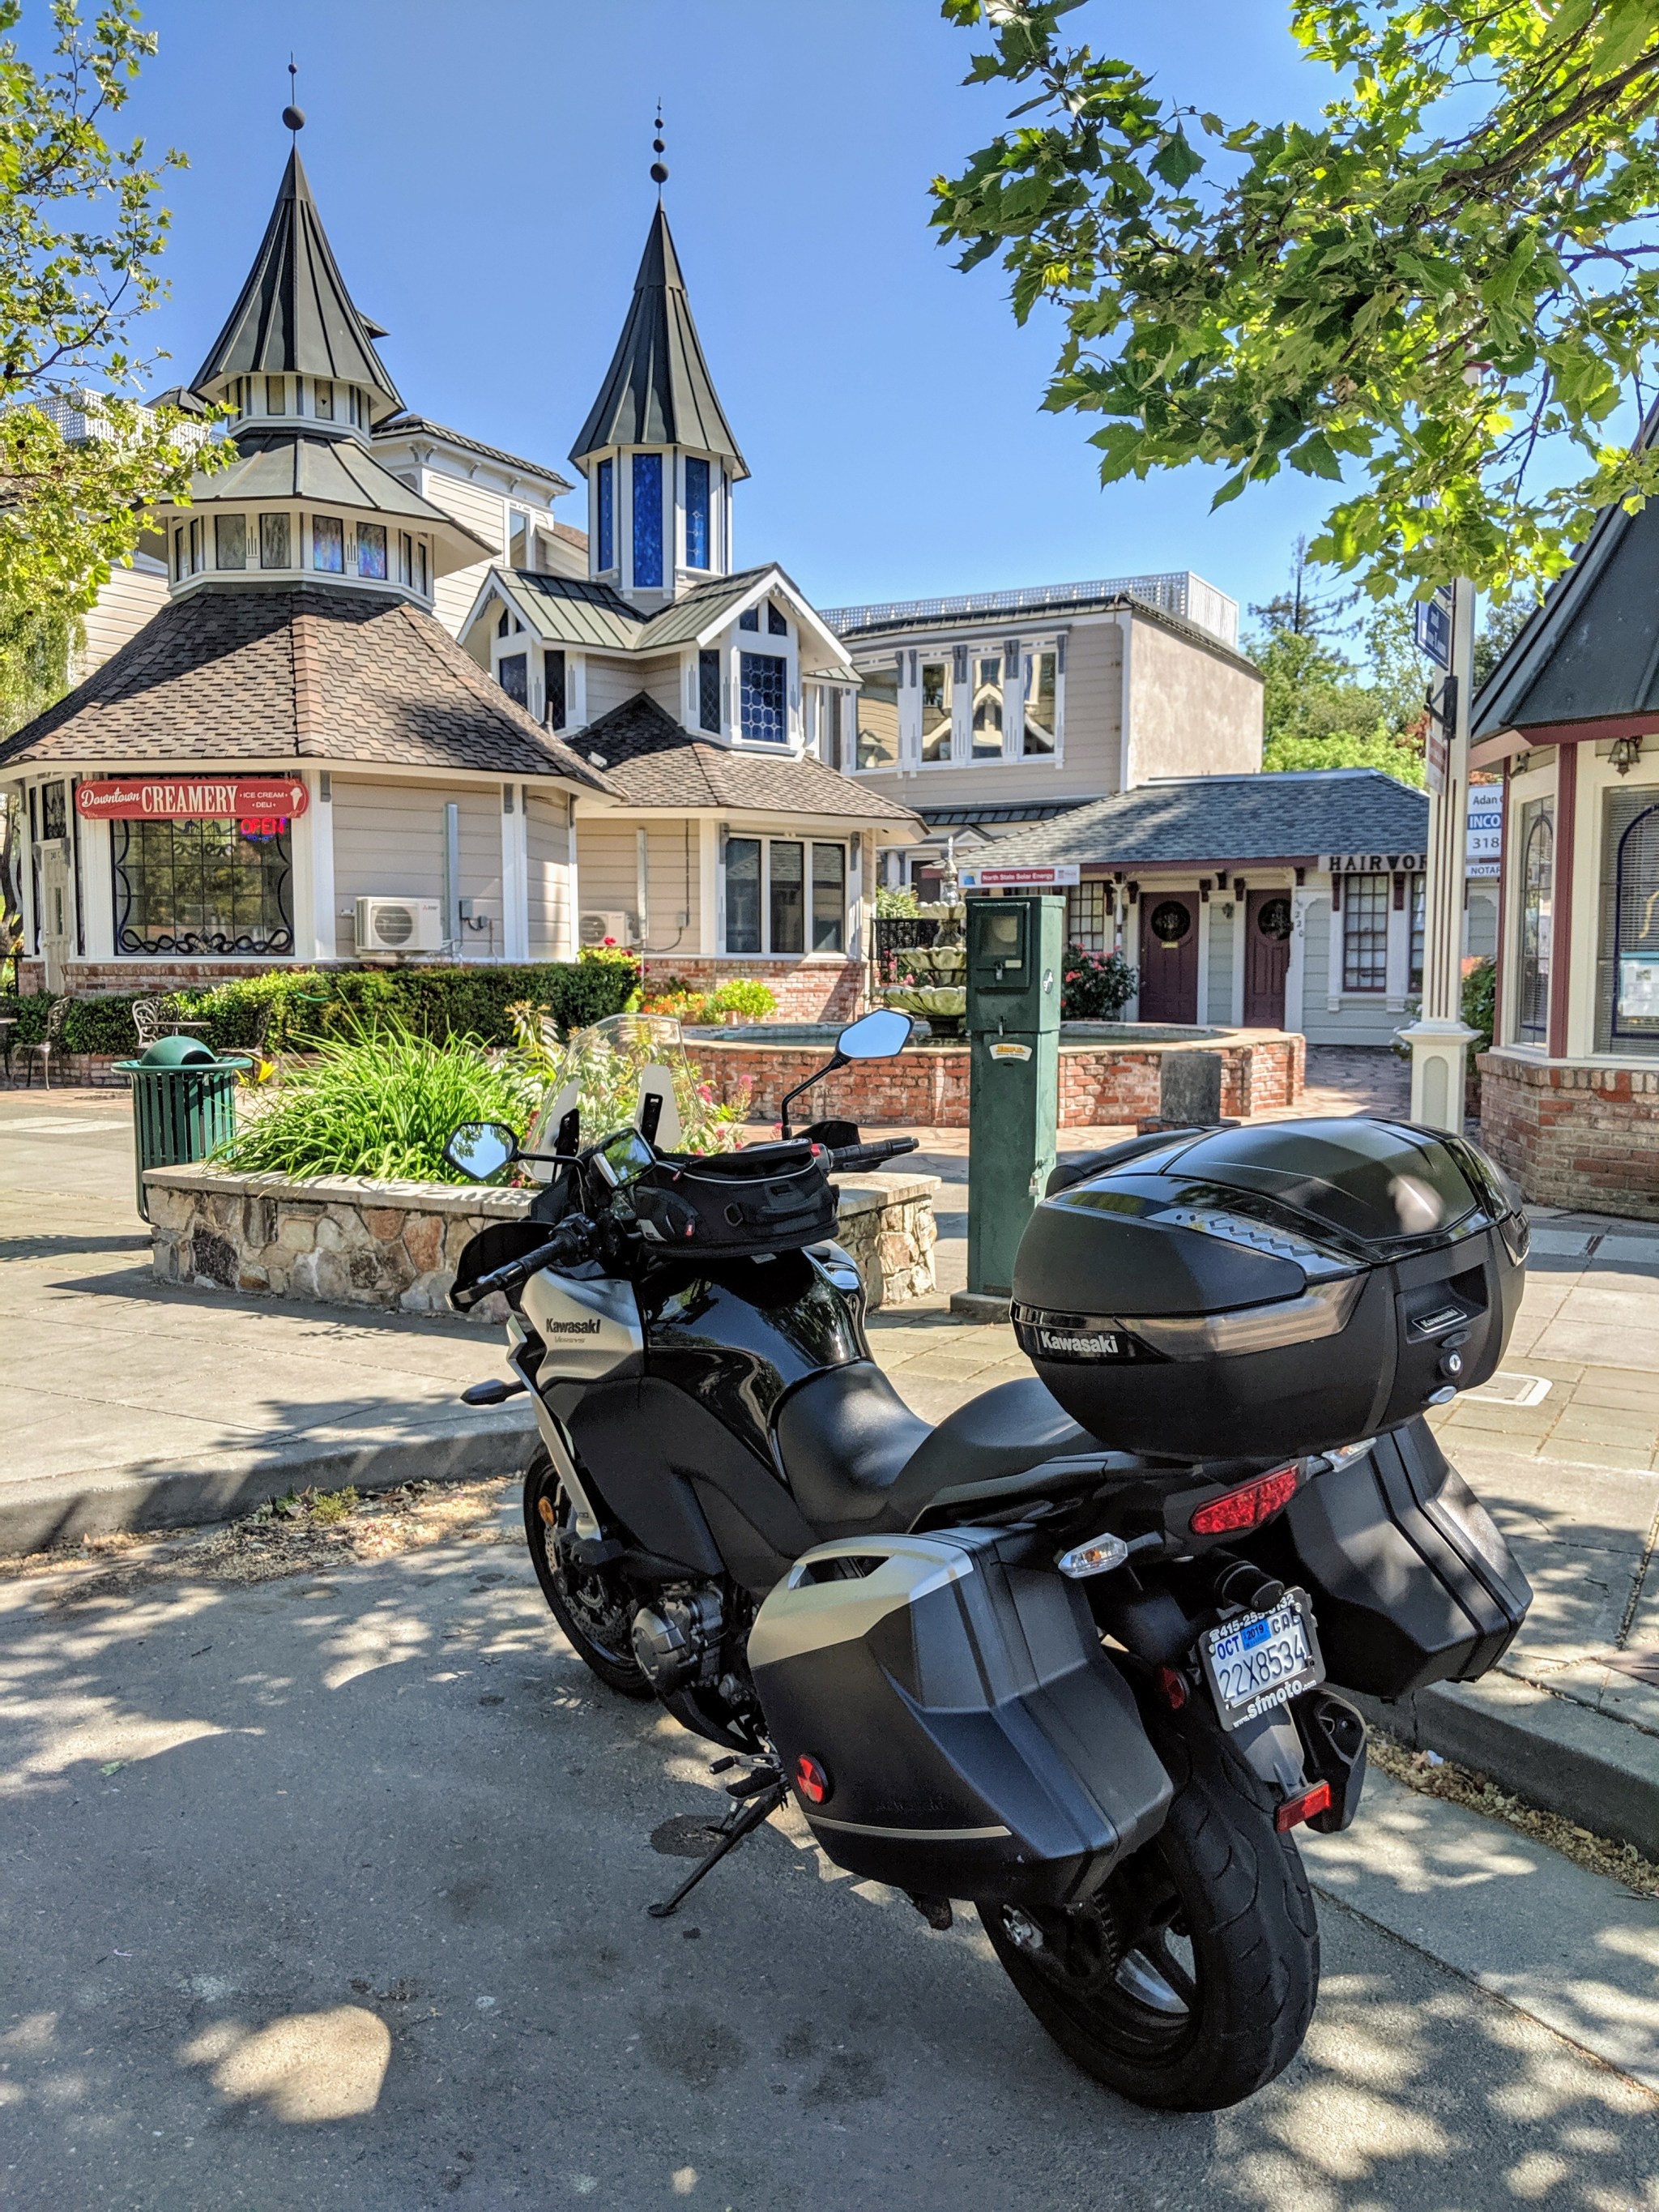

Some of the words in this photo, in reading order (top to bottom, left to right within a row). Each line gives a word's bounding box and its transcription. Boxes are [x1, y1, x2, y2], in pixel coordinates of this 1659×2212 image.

[81, 788, 140, 808] Downtown
[142, 785, 237, 813] CREAMERY
[1473, 796, 1498, 805] Adan
[1032, 872, 1053, 881] Energy
[546, 1318, 601, 1334] Kawasaki
[1419, 1308, 1459, 1327] Kawasaki
[1040, 1330, 1119, 1353] Kawasaki
[1217, 1636, 1240, 1660] OCT
[1247, 1624, 1265, 1640] 2019
[1219, 1634, 1307, 1700] 22X8534
[1233, 1679, 1317, 1728] www.sfmoto.com
